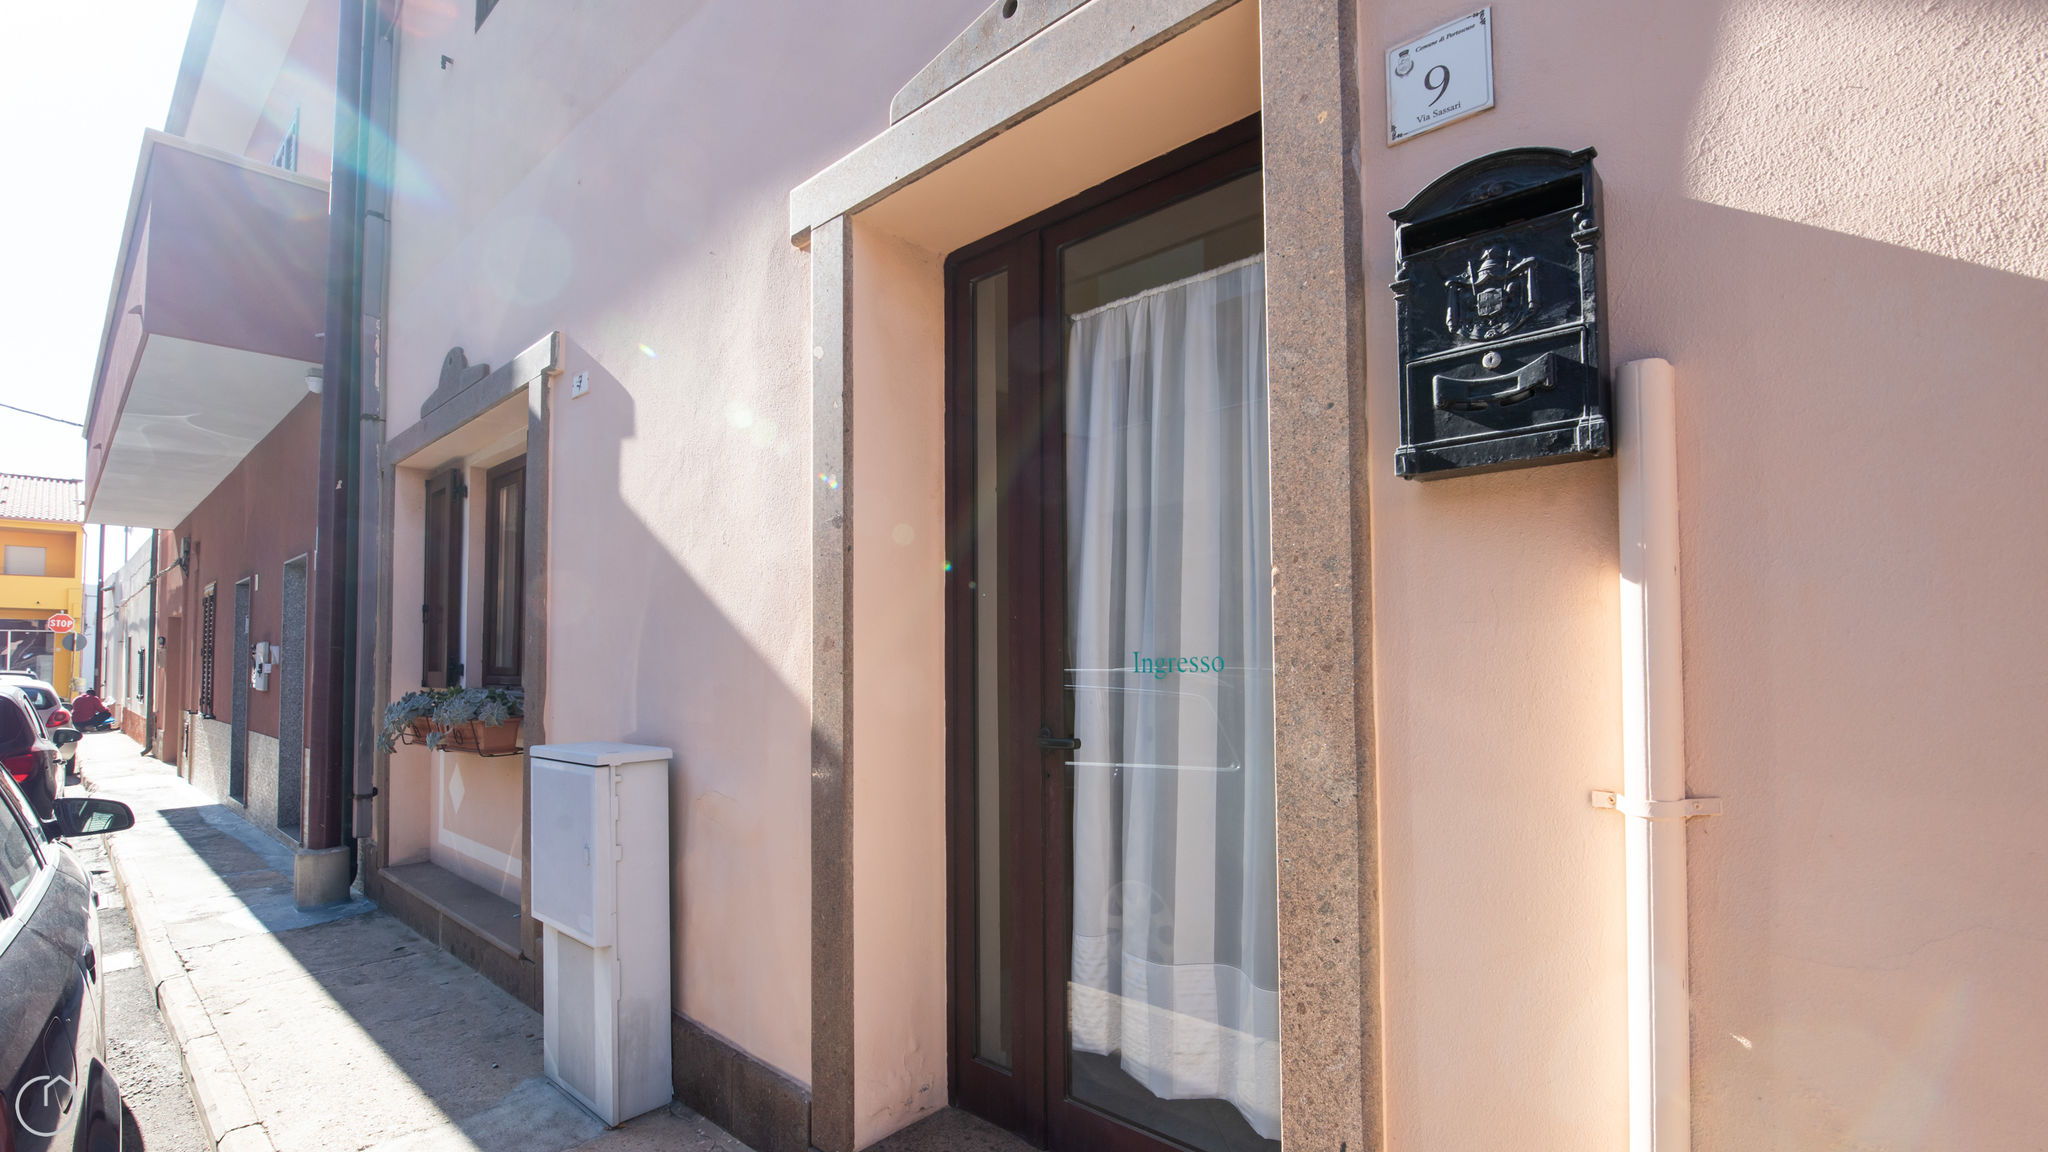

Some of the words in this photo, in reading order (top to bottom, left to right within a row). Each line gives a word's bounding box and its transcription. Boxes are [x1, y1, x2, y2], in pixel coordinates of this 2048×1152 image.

[1424, 65, 1450, 107] 9
[1416, 113, 1431, 123] Via
[1433, 101, 1461, 117] Sassari
[50, 619, 73, 628] STOP
[1132, 651, 1225, 680] Ingresso
